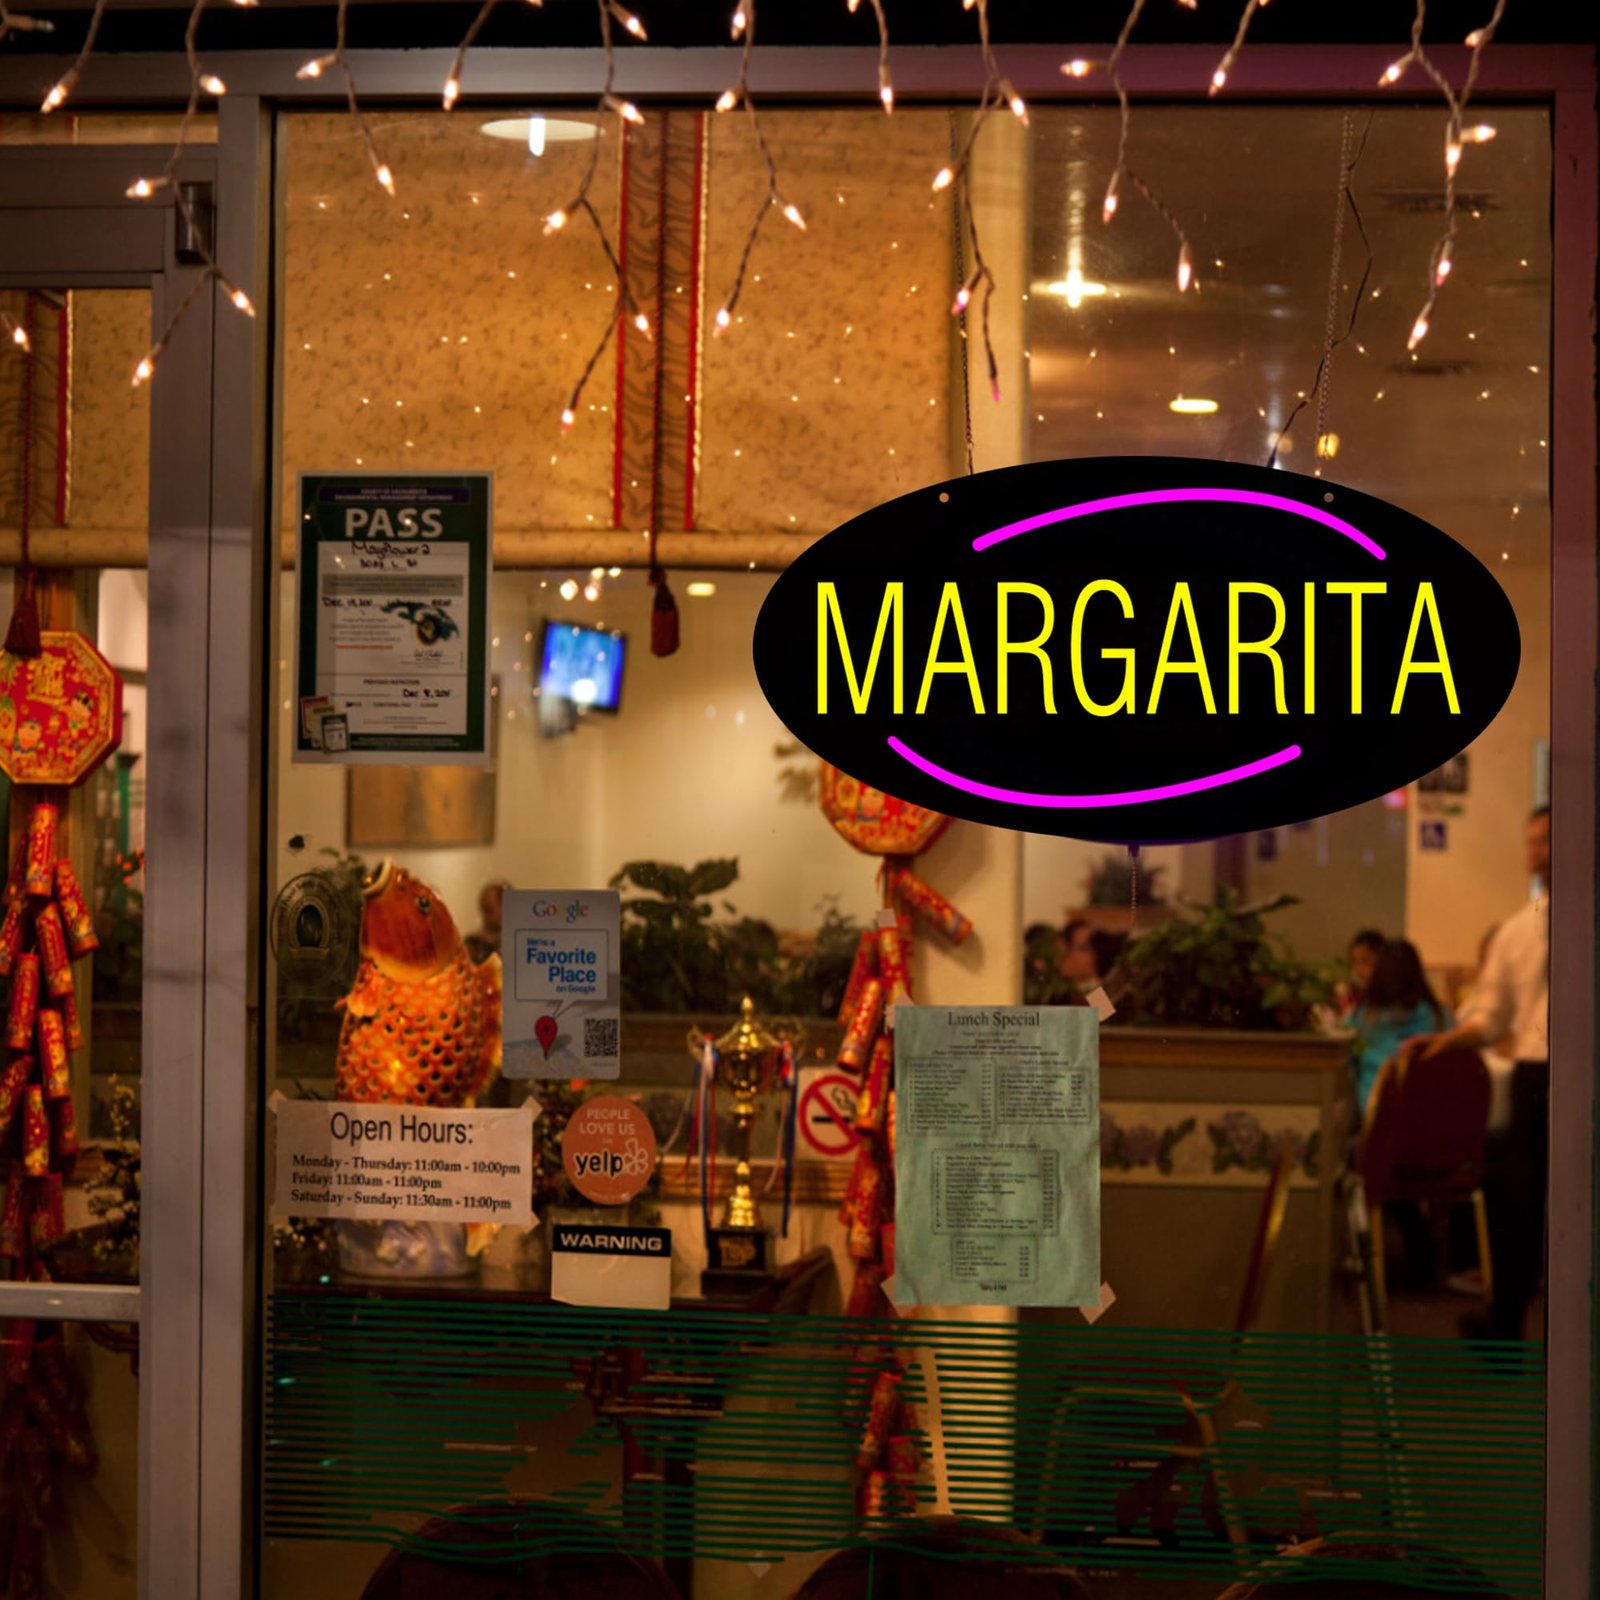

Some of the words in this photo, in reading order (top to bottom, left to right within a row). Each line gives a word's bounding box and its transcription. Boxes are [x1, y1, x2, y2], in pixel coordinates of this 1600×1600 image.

[345, 508, 443, 538] PASS
[817, 579, 1460, 716] MARGARITA
[533, 899, 589, 923] Google
[527, 948, 597, 964] Favorite
[548, 966, 597, 983] Place
[948, 1012, 989, 1026] Lunch
[992, 1012, 1040, 1029] Special
[586, 1108, 630, 1119] PEOPLE
[330, 1111, 392, 1146] Open
[400, 1115, 473, 1145] Hours:
[579, 1122, 615, 1134] LOVE
[618, 1122, 636, 1135] US
[292, 1154, 343, 1170] Monday
[352, 1156, 412, 1172] Thursday:
[414, 1159, 462, 1172] 11:00am
[472, 1161, 521, 1177] 10:00pm
[574, 1148, 624, 1179] yelp
[292, 1172, 333, 1187] Friday:
[336, 1175, 383, 1187] 11:00am
[394, 1176, 442, 1191] 11:00pm
[291, 1189, 345, 1206] Saturday
[354, 1192, 403, 1208] Sunday:
[406, 1194, 453, 1207] 11:30am
[463, 1196, 511, 1211] 11:00pm
[560, 1232, 663, 1251] WARNING
